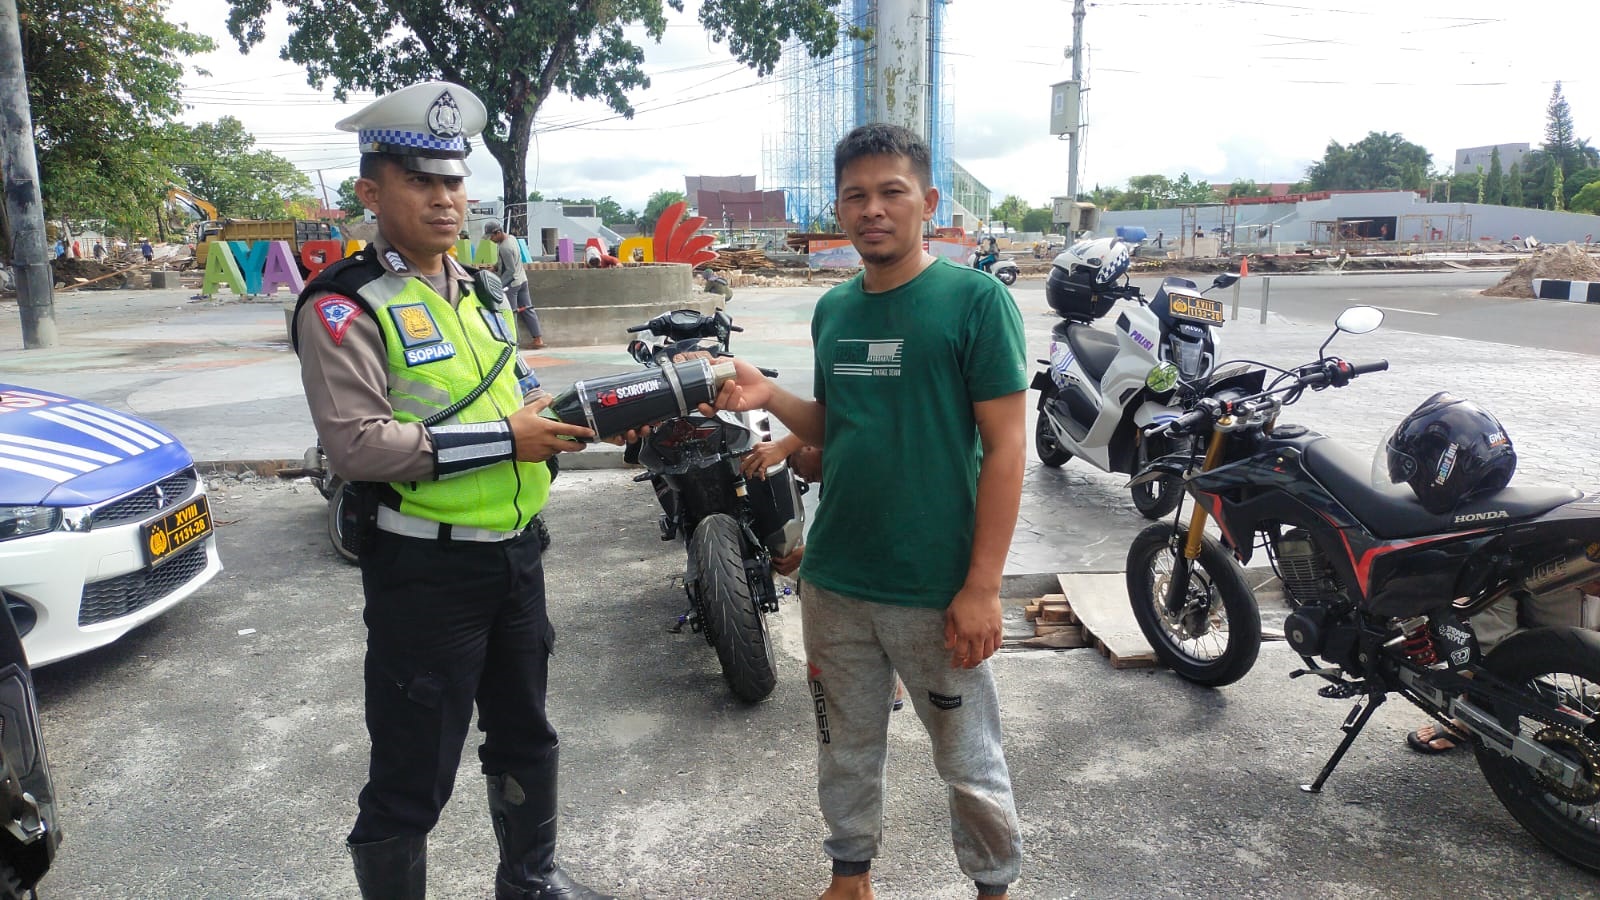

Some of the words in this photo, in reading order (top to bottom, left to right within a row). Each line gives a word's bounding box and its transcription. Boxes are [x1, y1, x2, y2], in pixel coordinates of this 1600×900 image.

[1130, 330, 1154, 351] POLISI
[408, 345, 455, 362] SOPIAN
[616, 379, 659, 399] SCORPION
[175, 503, 198, 526] XVIII
[1454, 510, 1509, 523] HONDA
[174, 518, 206, 545] 1131-28
[813, 680, 830, 744] EIGER
